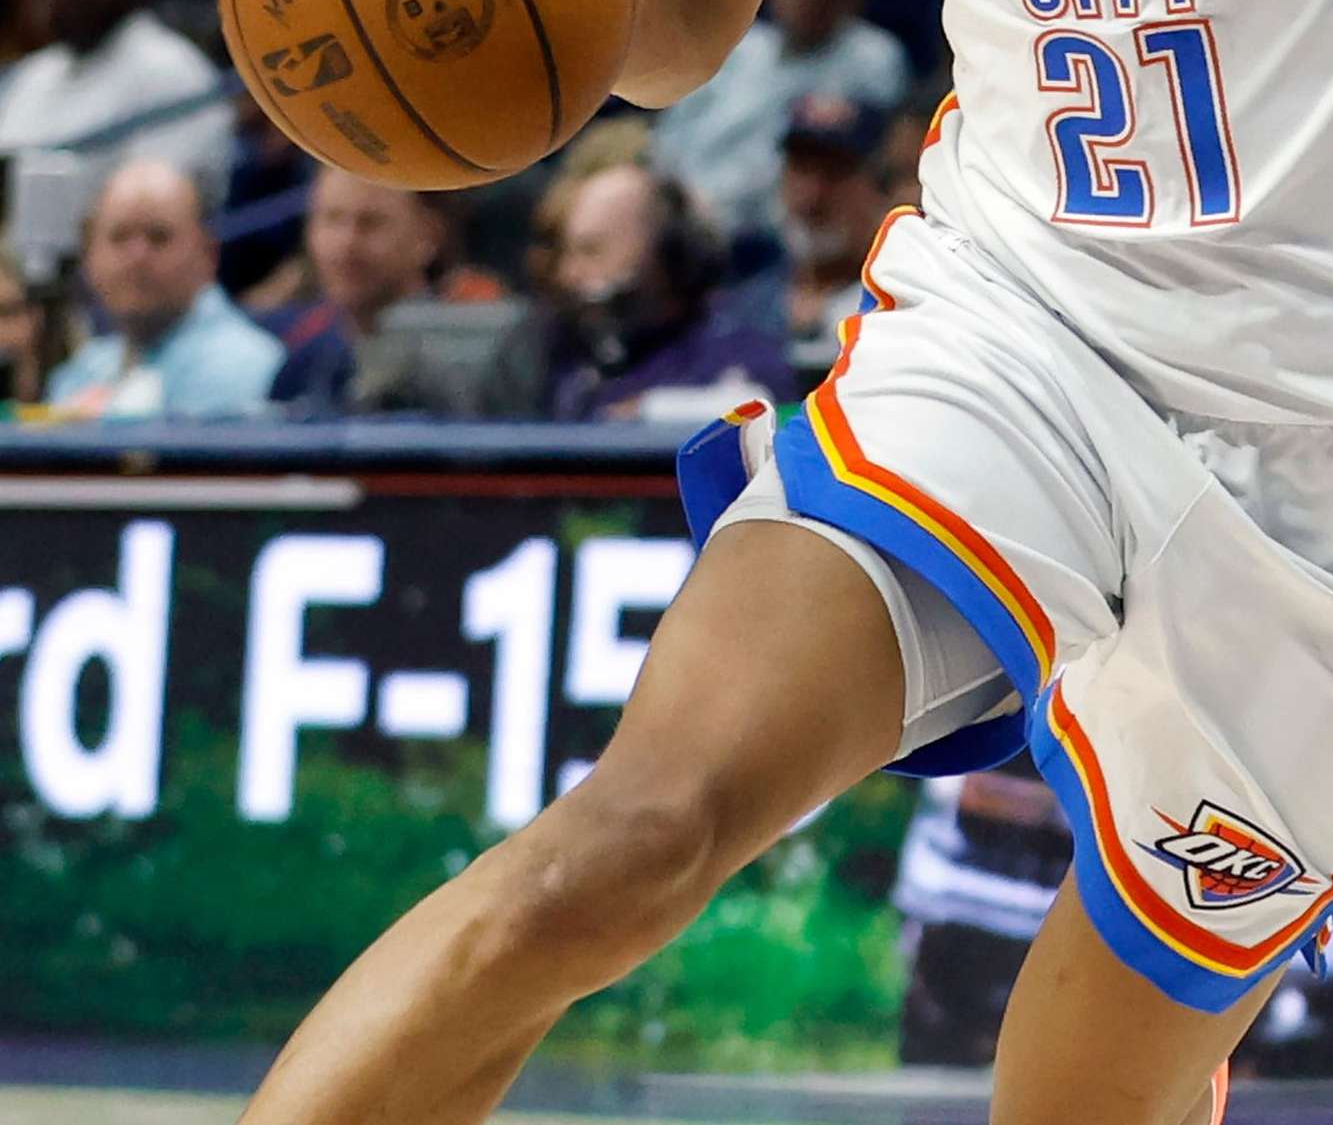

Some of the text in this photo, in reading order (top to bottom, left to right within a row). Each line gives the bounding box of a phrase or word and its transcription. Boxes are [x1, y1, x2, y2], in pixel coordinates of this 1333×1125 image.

[1037, 19, 1240, 228] 21
[236, 532, 832, 837] F-15
[1155, 832, 1281, 880] OKC
